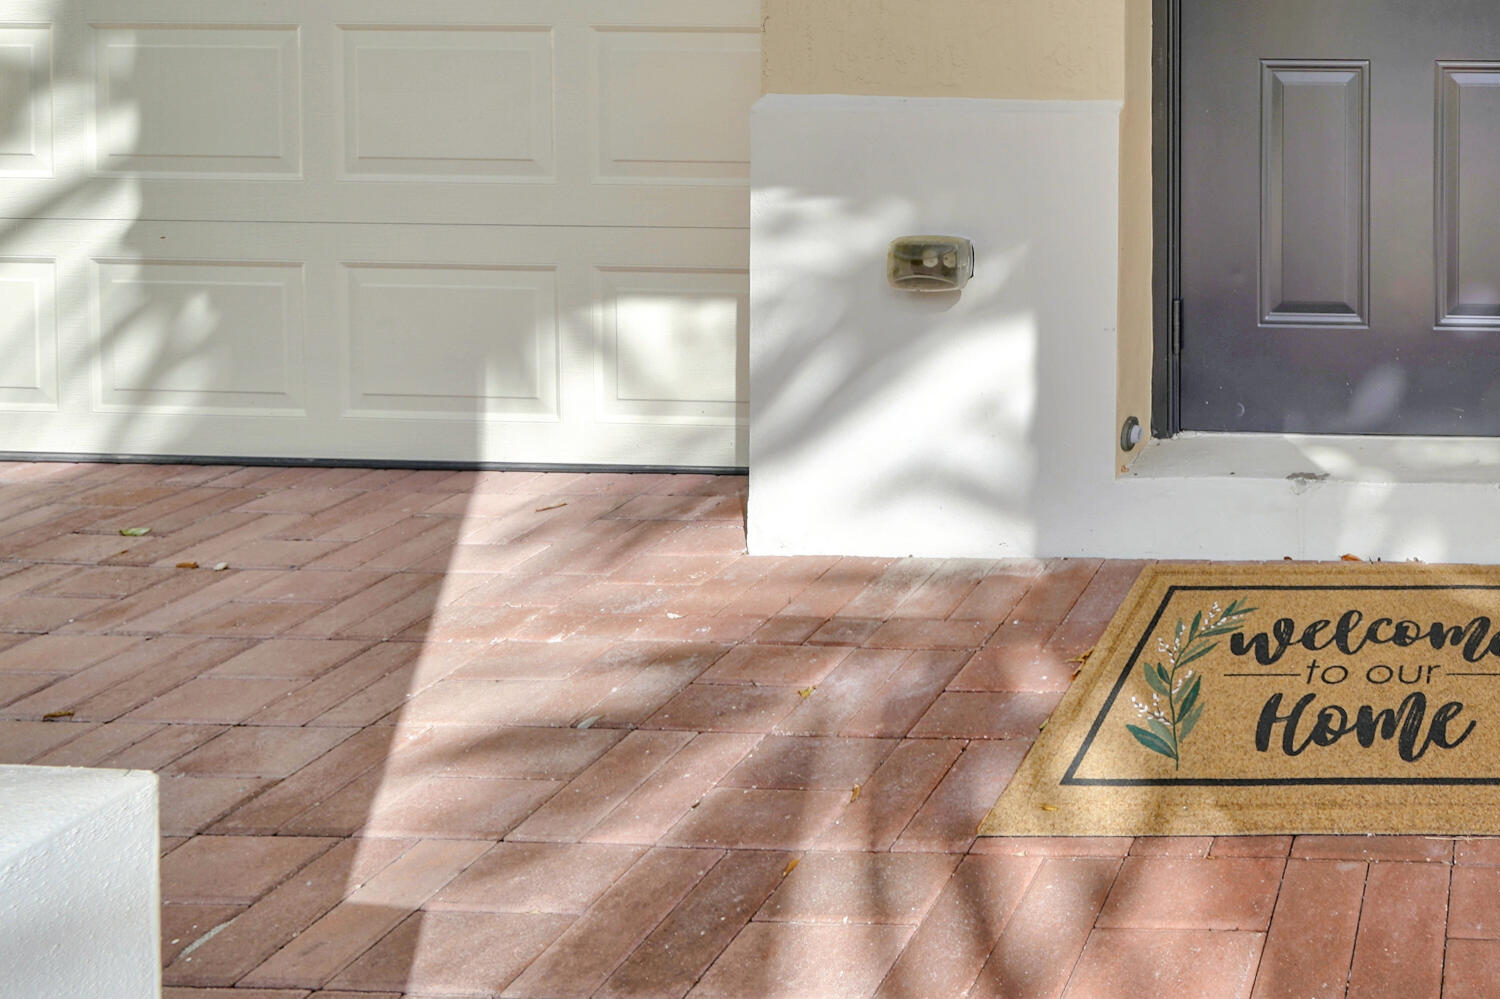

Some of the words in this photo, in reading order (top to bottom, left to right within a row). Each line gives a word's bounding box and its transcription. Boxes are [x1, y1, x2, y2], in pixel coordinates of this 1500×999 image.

[1306, 659, 1348, 684] to
[1366, 662, 1441, 685] our
[1255, 692, 1476, 762] Home
